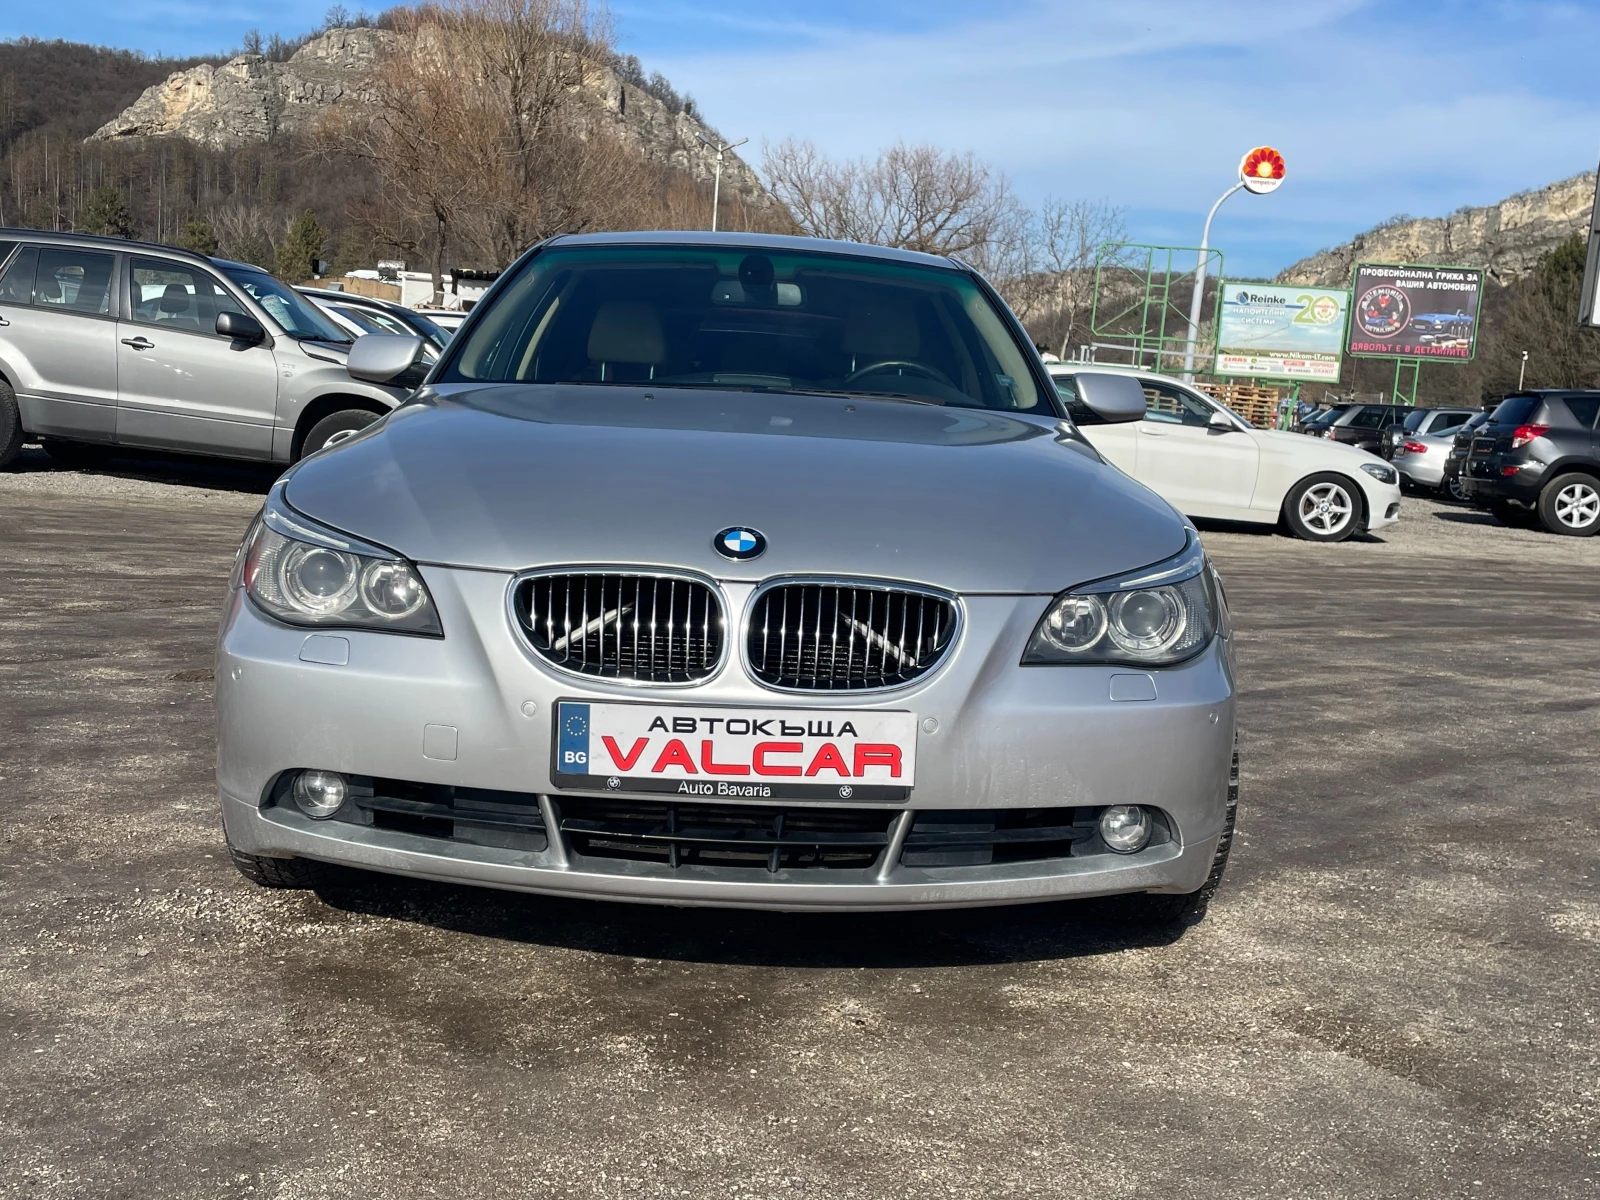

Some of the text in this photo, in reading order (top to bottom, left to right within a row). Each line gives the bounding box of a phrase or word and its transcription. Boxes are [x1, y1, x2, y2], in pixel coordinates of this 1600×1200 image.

[1360, 268, 1478, 282] ПРОФЕСИОНАЛНА ГРИЖА ЗА
[1395, 280, 1477, 292] ВАШИЯ АВТОМОБИЛ
[1250, 294, 1286, 305] Reinke
[1233, 307, 1285, 317] НАПОИТЕЛНИ
[1240, 317, 1276, 325] СИСТЕМИ
[1405, 345, 1411, 353] В
[1269, 352, 1336, 362] www.Nikom-LT.com
[648, 716, 858, 737] АВТОКЪЩА
[564, 751, 587, 764] BG
[601, 736, 902, 778] VALCAR
[677, 780, 771, 797] Auto Bavaria
